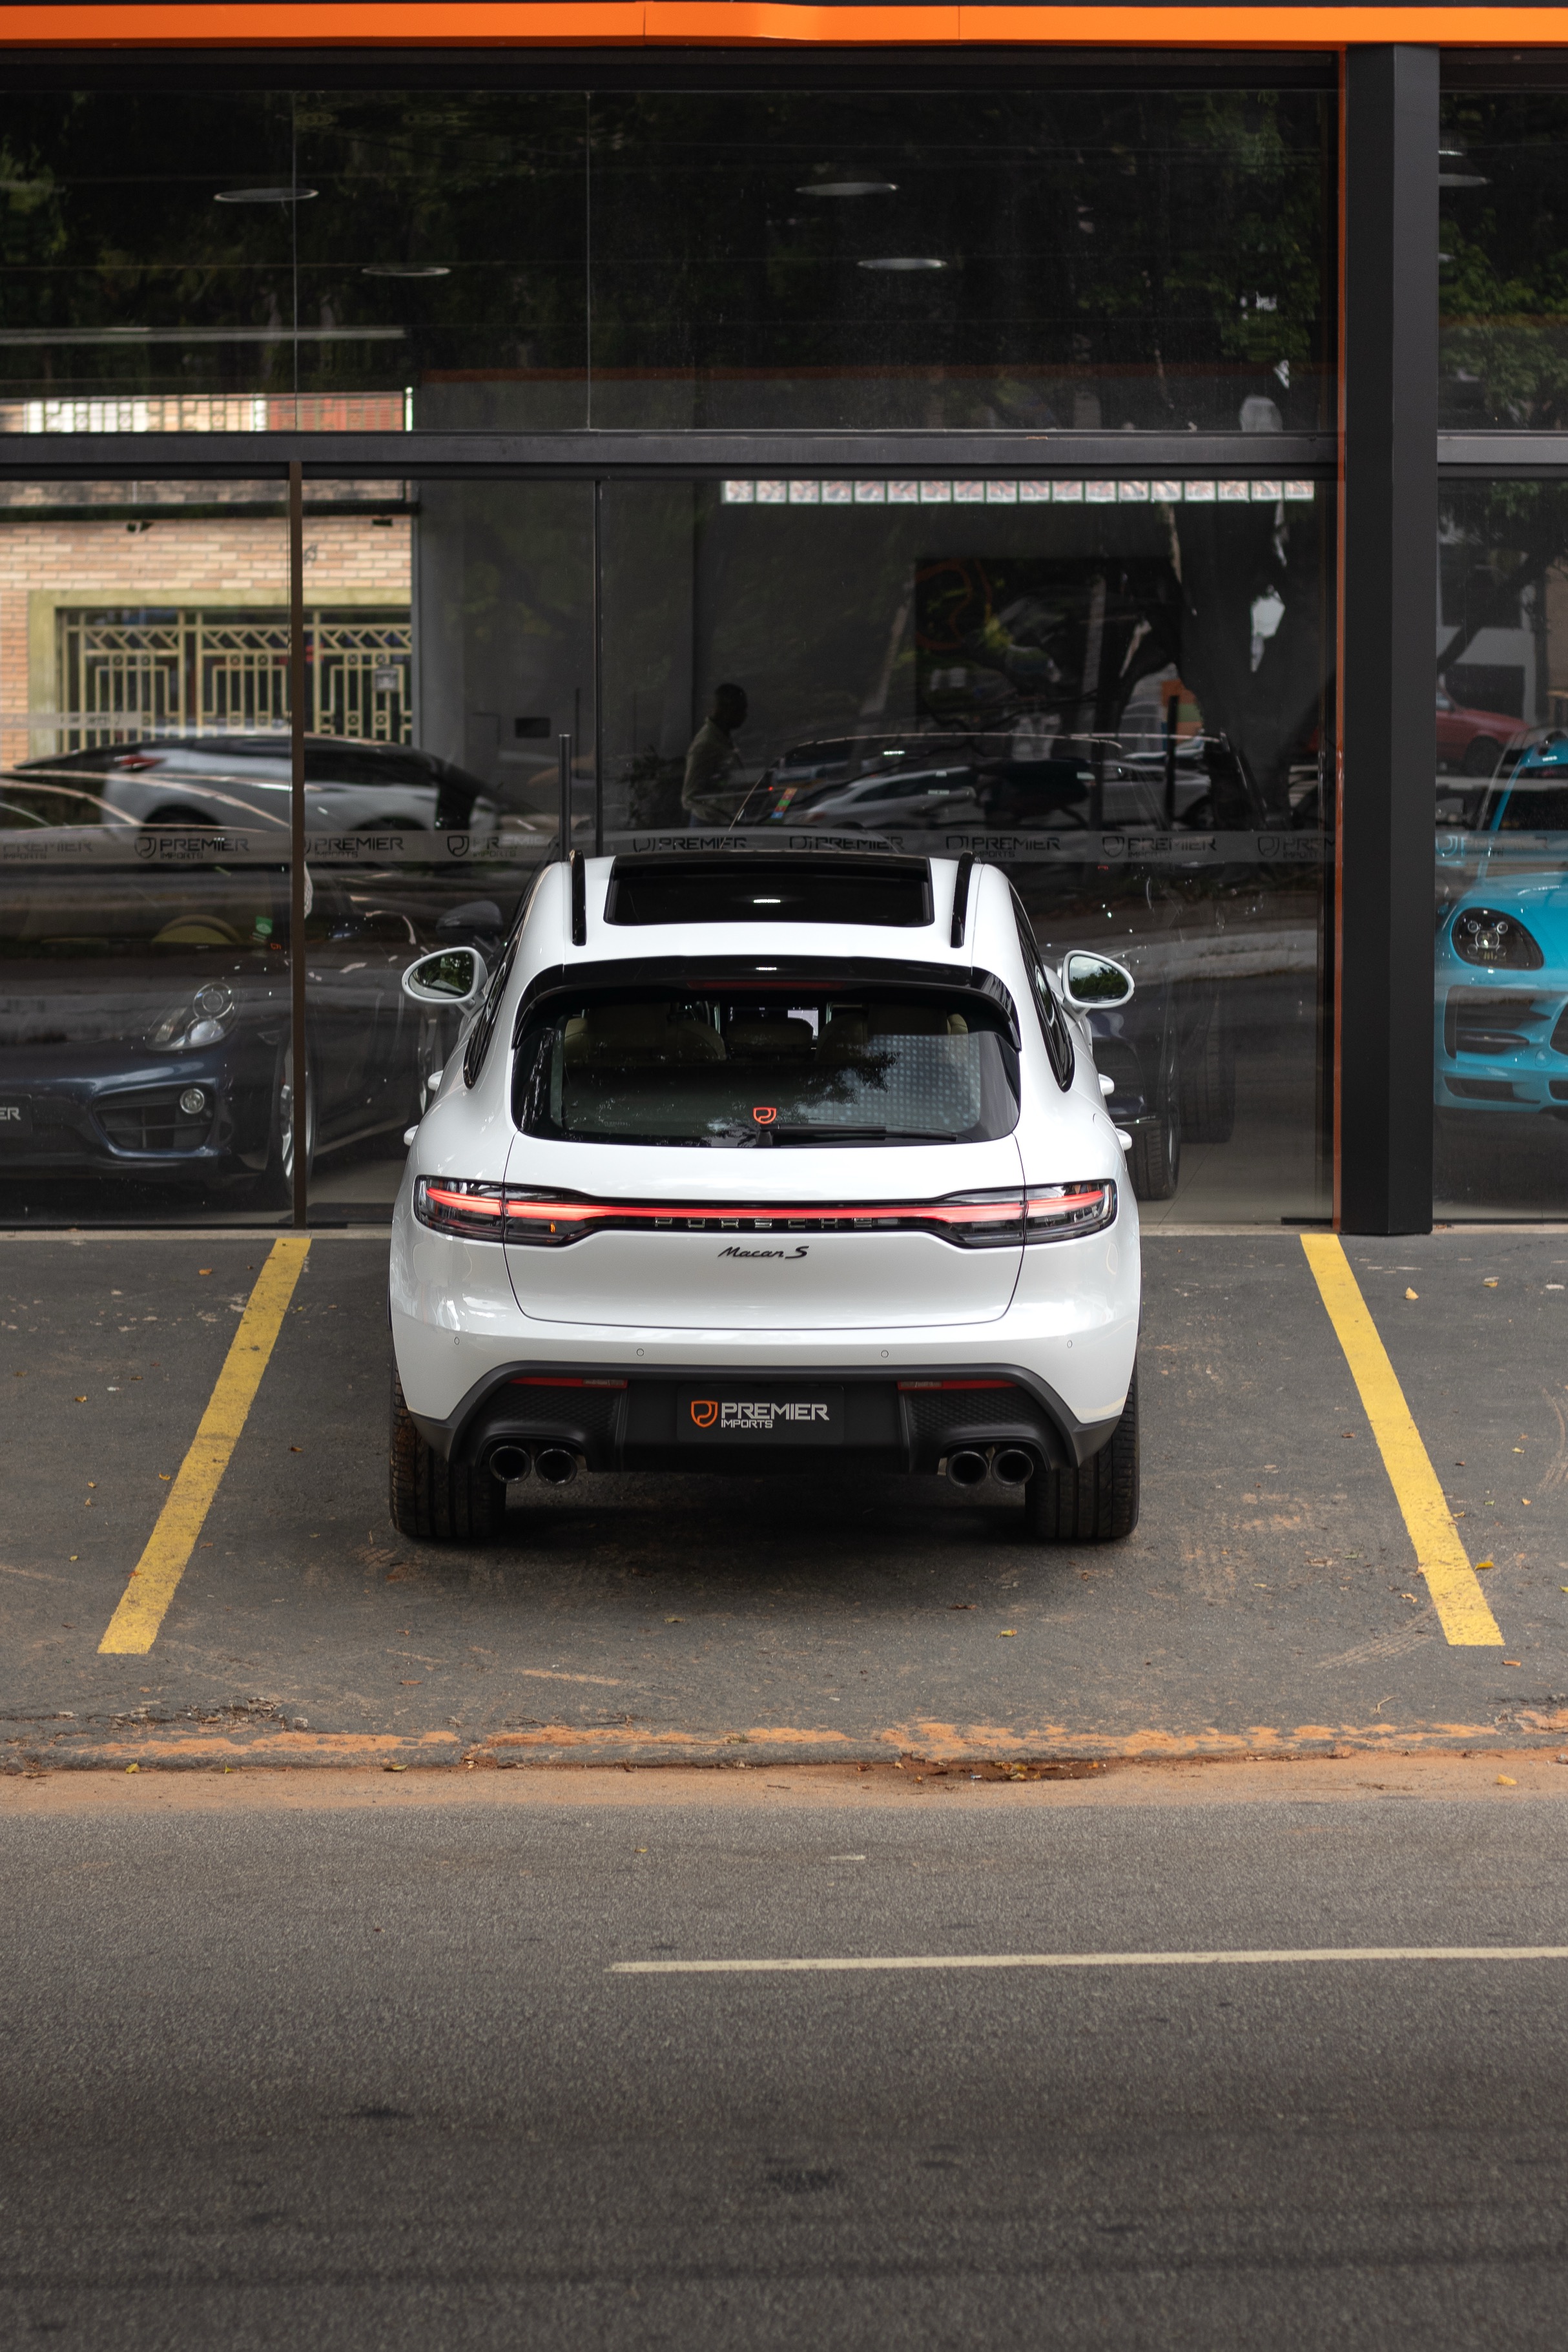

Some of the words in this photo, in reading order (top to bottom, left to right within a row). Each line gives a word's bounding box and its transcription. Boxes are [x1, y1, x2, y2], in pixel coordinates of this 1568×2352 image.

[160, 838, 250, 851] PREMIER
[315, 837, 404, 851] PREMIER
[659, 837, 747, 850] PREMIER
[816, 836, 905, 850] PREMIER
[972, 837, 1061, 851] PREMIER
[655, 1217, 872, 1228] PORSCHE
[717, 1246, 784, 1258] Macan
[784, 1246, 809, 1259] S
[721, 1402, 830, 1421] PREMIER
[721, 1419, 773, 1429] IMPORTS
